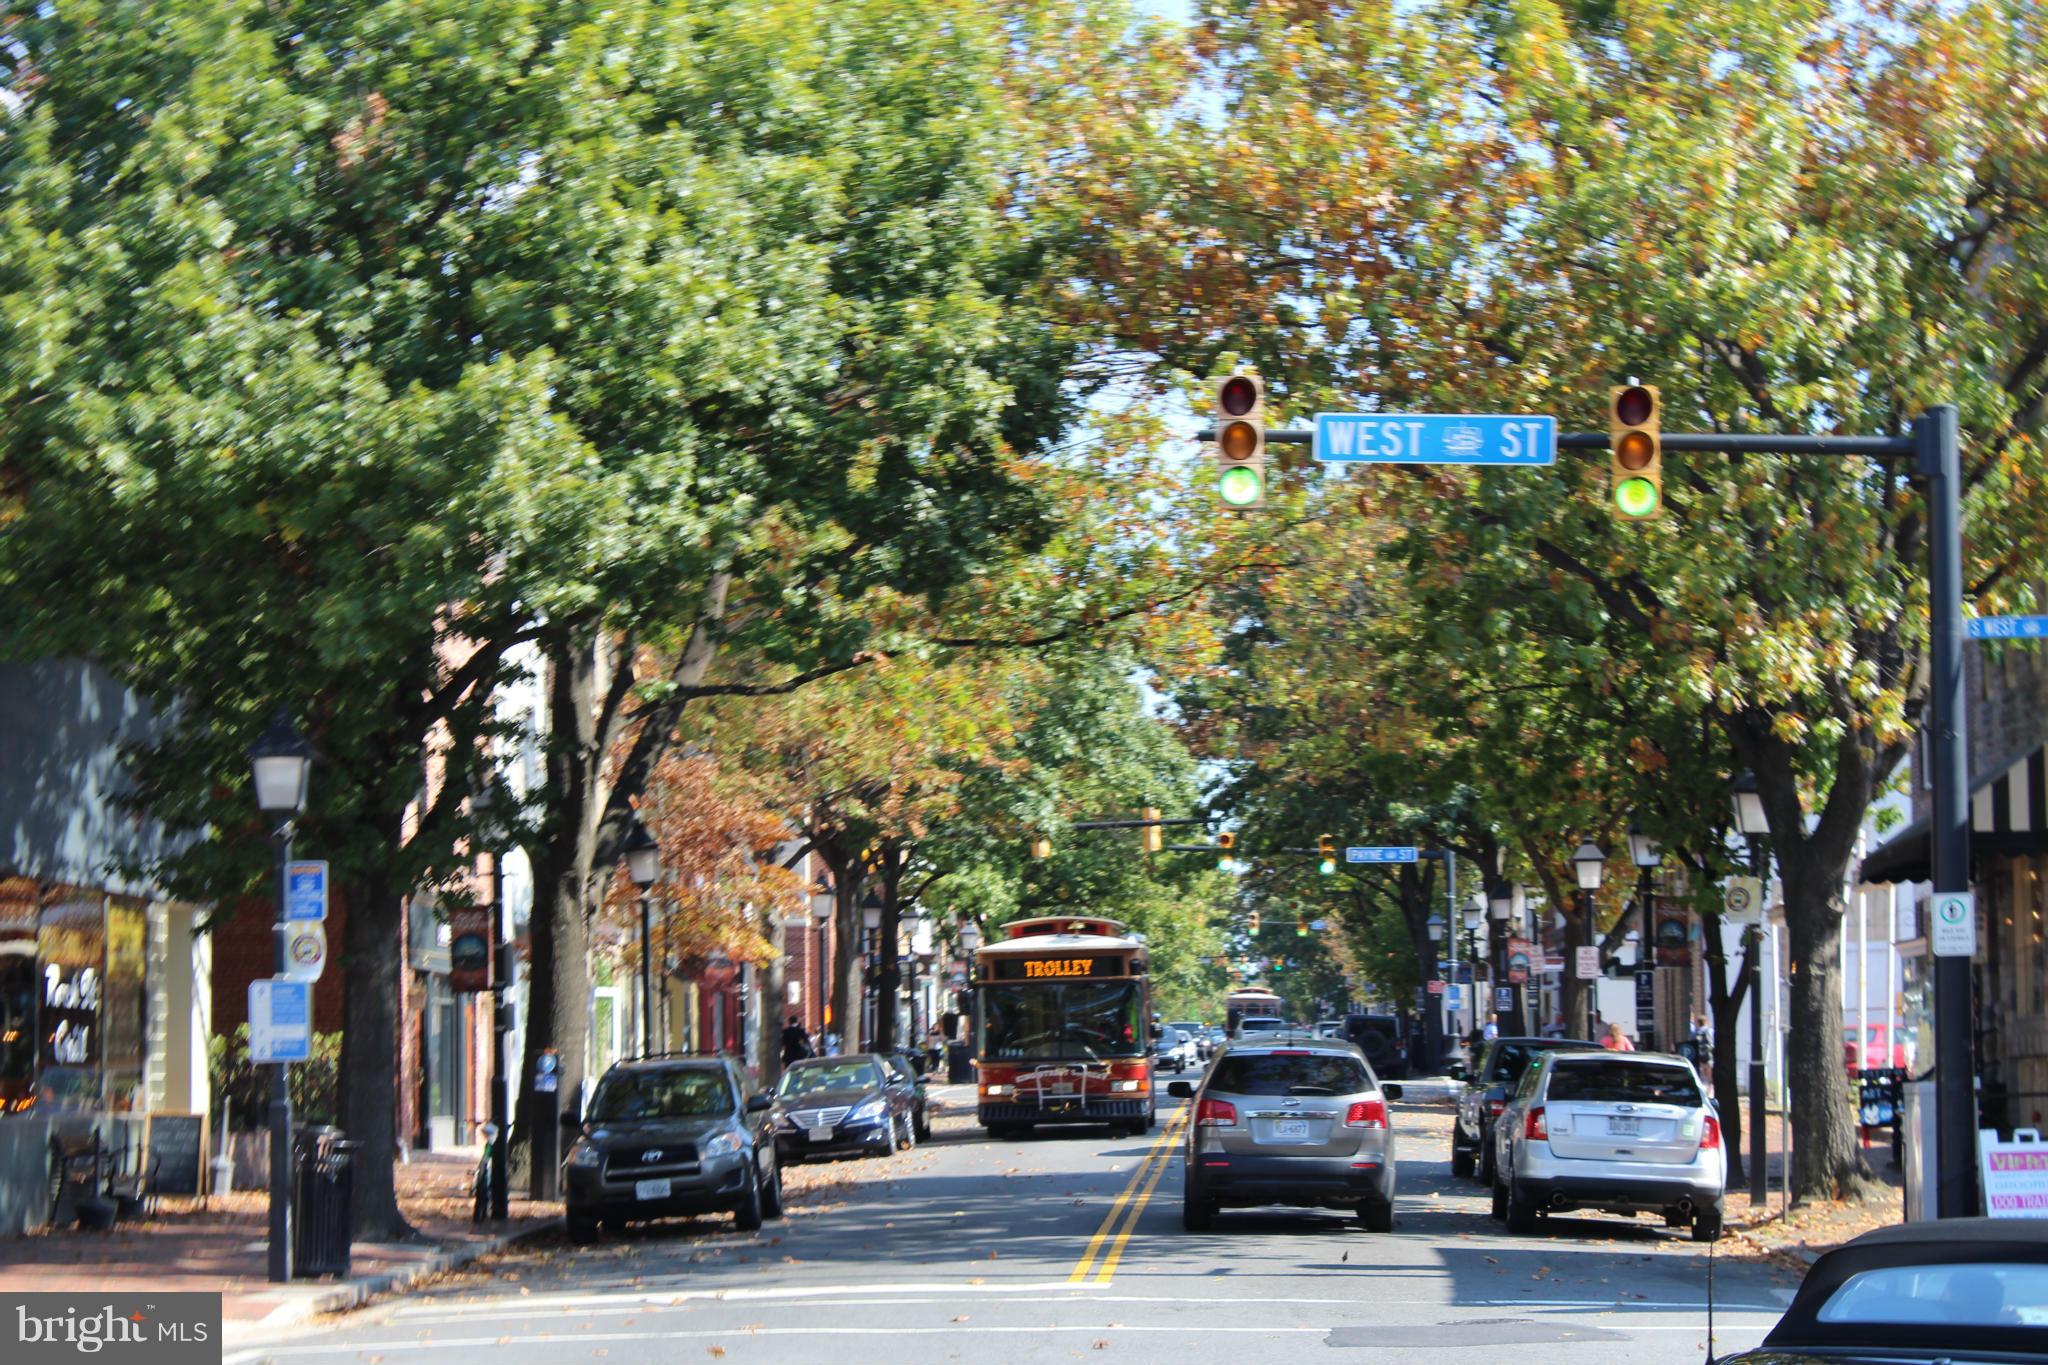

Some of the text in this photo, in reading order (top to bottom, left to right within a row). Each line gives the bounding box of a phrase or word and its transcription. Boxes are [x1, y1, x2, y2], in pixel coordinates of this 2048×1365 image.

[1326, 421, 1543, 458] WEST ST
[1984, 617, 2016, 637] WEST
[1399, 849, 1413, 860] ST
[1024, 959, 1093, 977] TROLLEY
